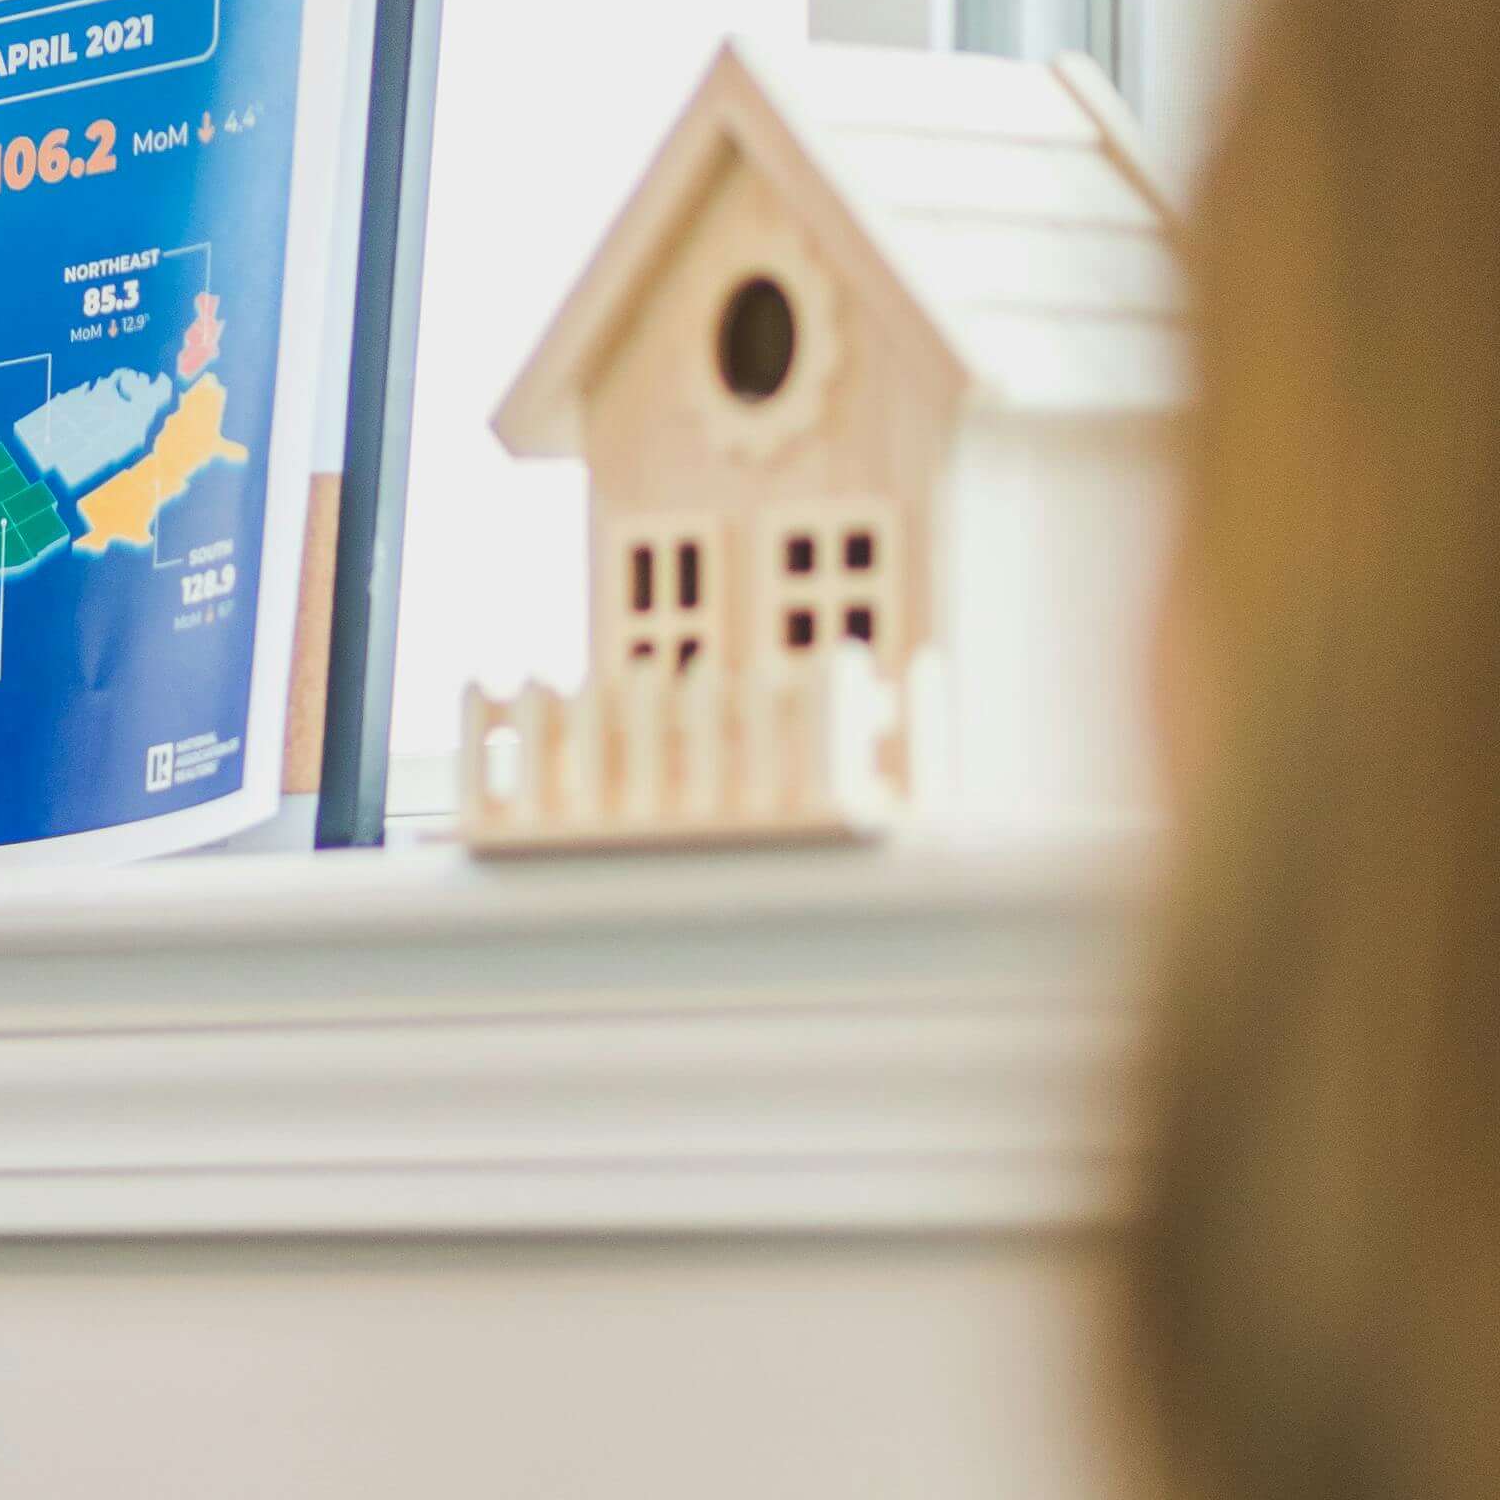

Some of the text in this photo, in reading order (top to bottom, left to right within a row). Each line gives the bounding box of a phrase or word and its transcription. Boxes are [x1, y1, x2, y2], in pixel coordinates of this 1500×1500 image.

[86, 14, 154, 58] 2021
[133, 120, 188, 156] MoM
[64, 247, 160, 284] NORTHEAST
[83, 279, 140, 317] 85.3
[70, 323, 102, 343] MoM
[181, 563, 236, 606] 128.9
